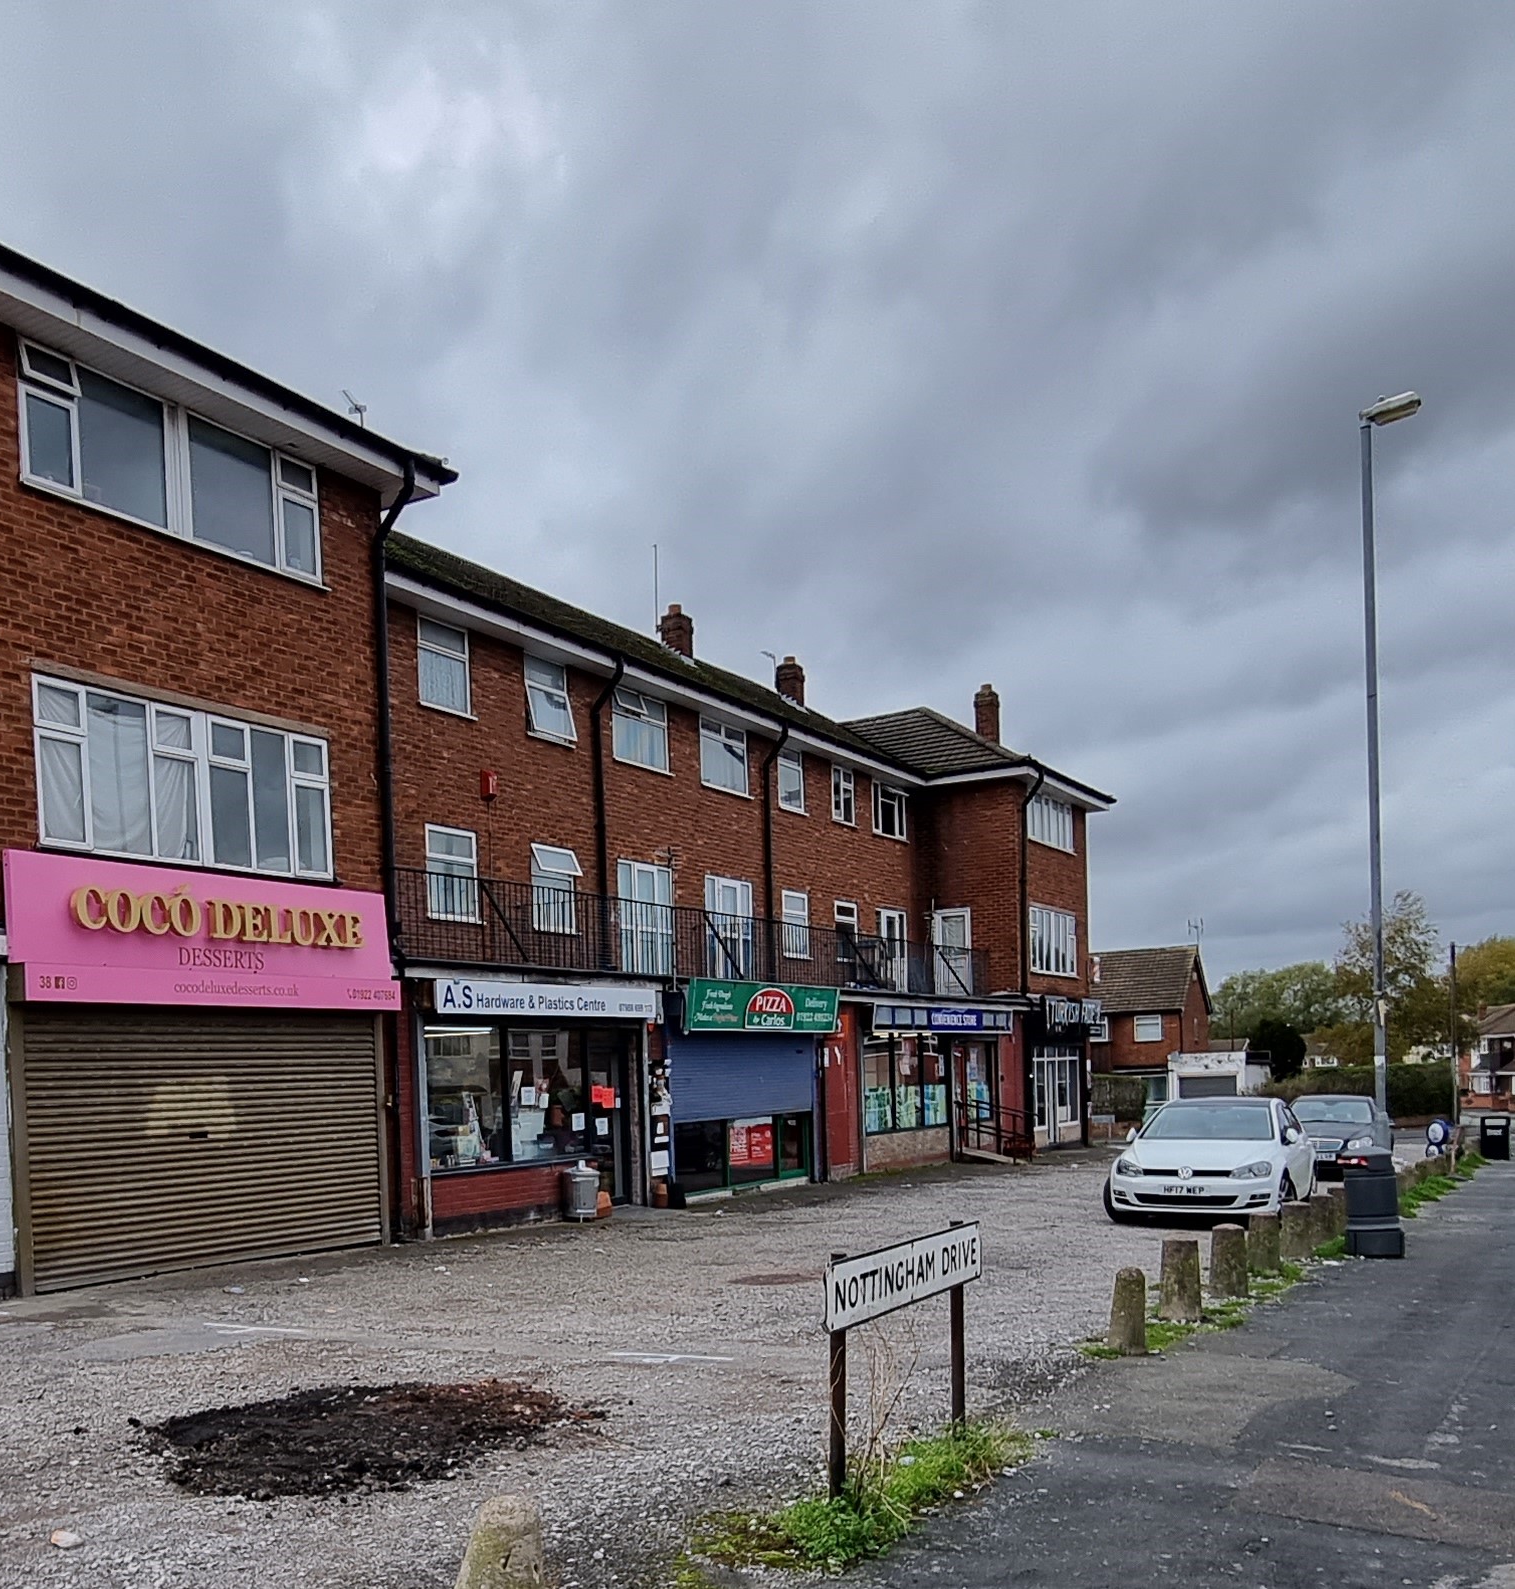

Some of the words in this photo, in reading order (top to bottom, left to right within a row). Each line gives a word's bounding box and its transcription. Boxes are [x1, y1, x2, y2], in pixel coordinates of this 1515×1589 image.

[206, 899, 365, 949] DELUXE
[178, 946, 266, 971] DESSERTS
[39, 975, 52, 989] 38
[174, 980, 299, 998] cocodeluxedesserts.co.uk
[443, 984, 473, 1009] A.S
[476, 992, 525, 1010] Hardware
[528, 995, 535, 1009] &
[538, 995, 575, 1011] Plastics
[577, 997, 606, 1012] Centre
[755, 995, 787, 1012] PIZZA
[761, 1014, 785, 1026] Carlos
[962, 1014, 977, 1026] STORE
[835, 1250, 935, 1314] NOTTINGHAM
[941, 1237, 977, 1276] DRIVE
